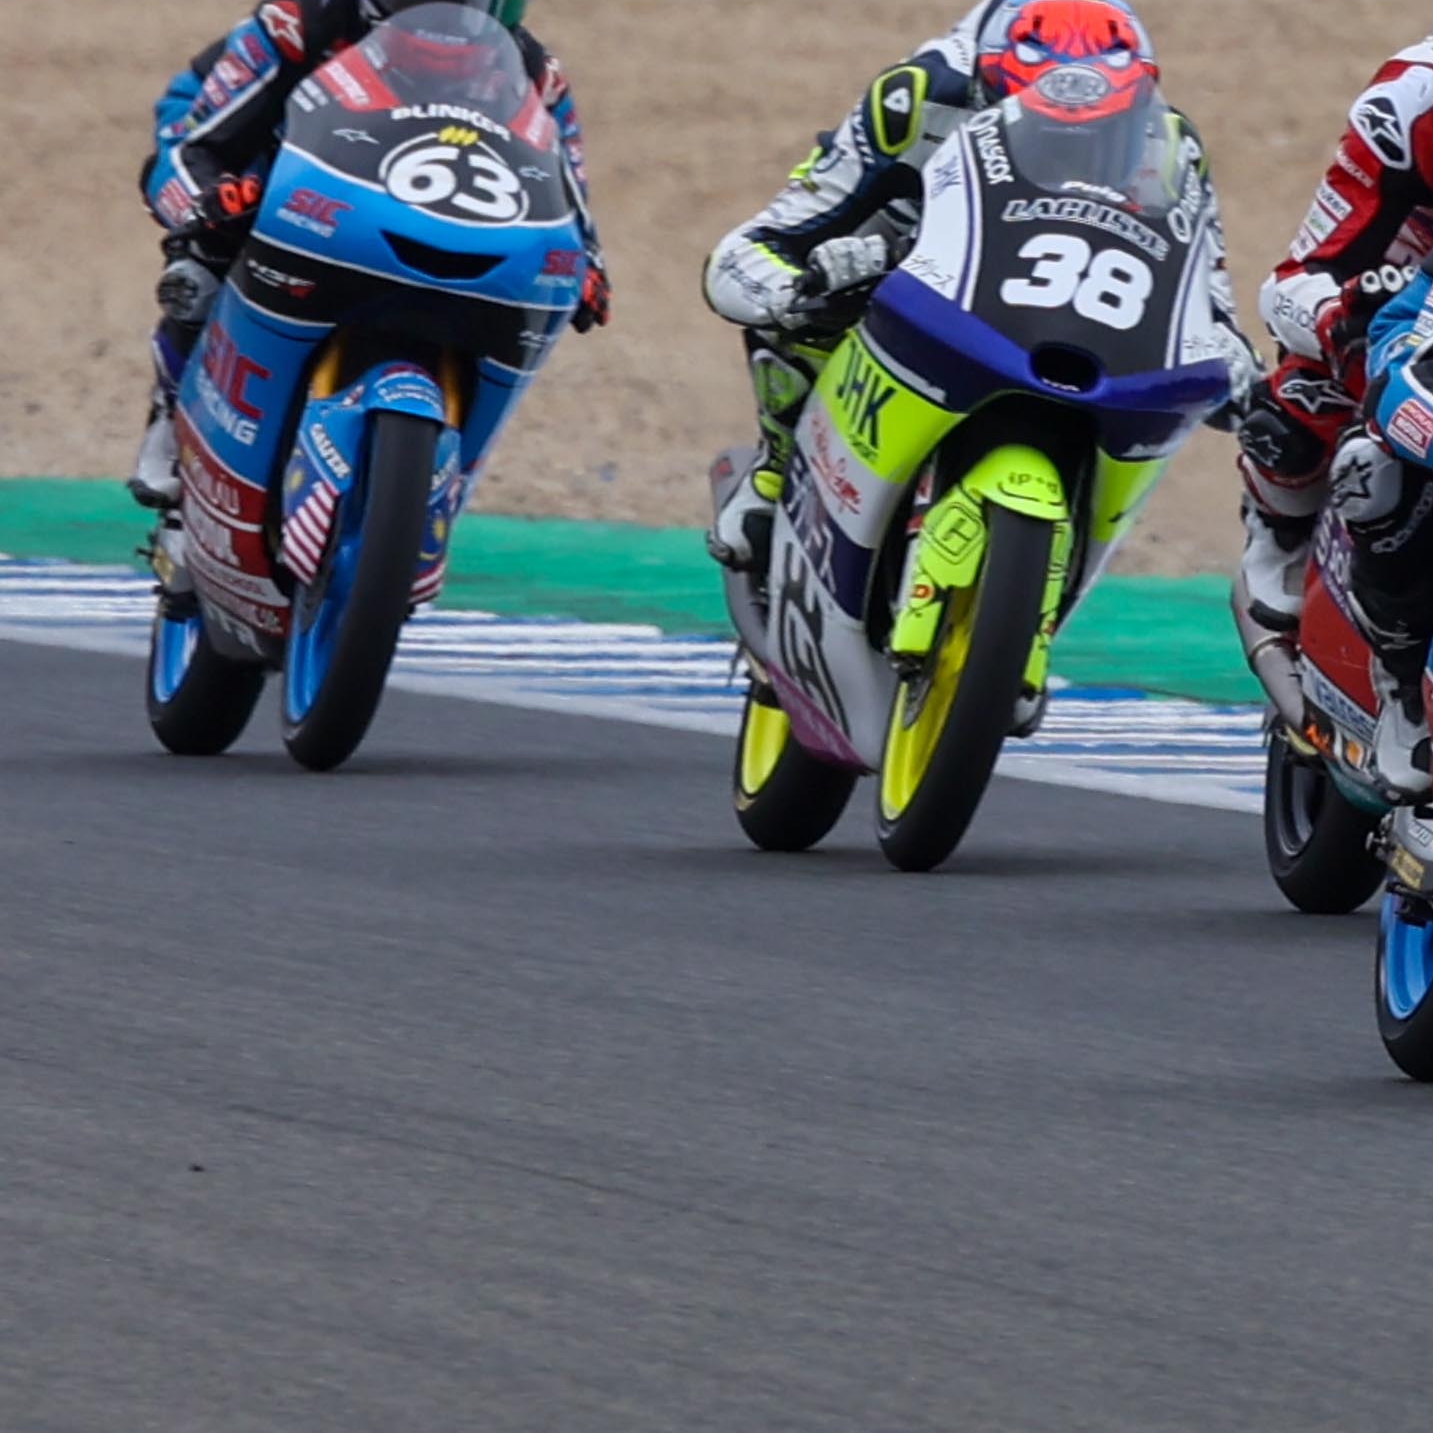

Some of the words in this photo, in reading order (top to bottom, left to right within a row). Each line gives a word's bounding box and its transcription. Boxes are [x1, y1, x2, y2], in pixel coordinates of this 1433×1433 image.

[390, 103, 512, 142] BLINKER
[386, 145, 521, 220] 63
[1000, 233, 1152, 331] 38
